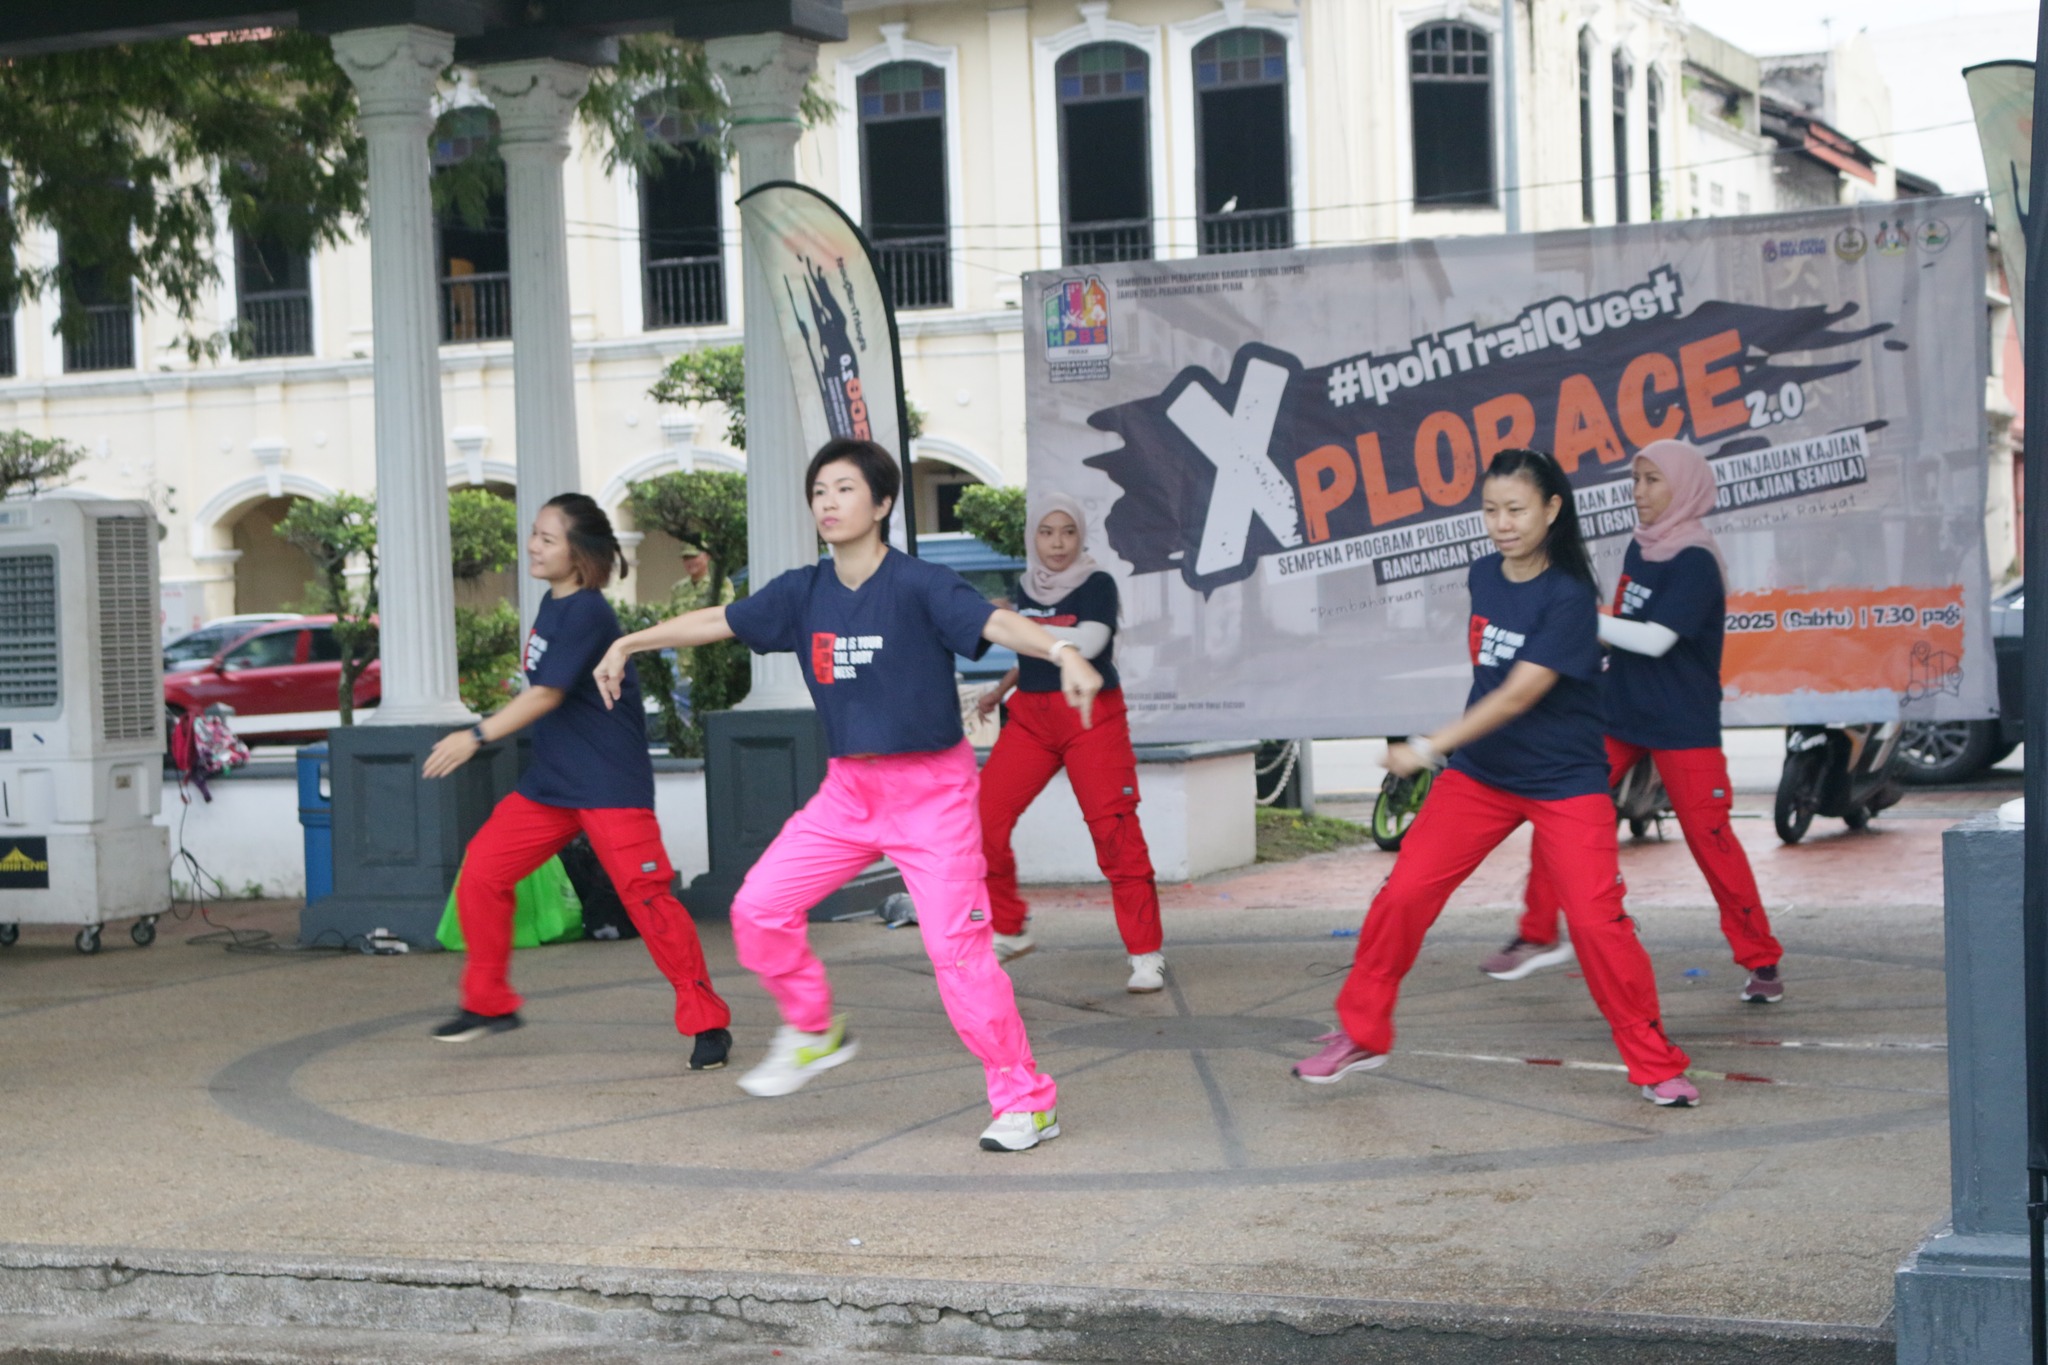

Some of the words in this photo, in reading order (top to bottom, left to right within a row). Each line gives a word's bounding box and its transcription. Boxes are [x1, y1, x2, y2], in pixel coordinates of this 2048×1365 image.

[1047, 326, 1107, 347] HPBS
[1327, 270, 1680, 406] #IpohTrailQuest
[1745, 382, 1804, 429] 2.0
[1277, 548, 1343, 577] SEMPENA
[1345, 536, 1414, 562] PROGRAM
[1416, 516, 1483, 546] PUBLISITI
[1611, 483, 1633, 505] AW
[1728, 447, 1802, 479] TINJAUAN
[1805, 433, 1862, 463] KAJIAN
[1381, 543, 1469, 581] RANCANGAN
[1470, 537, 1497, 562] STR
[1732, 472, 1795, 506] (KAJIAN
[1796, 456, 1866, 491] SEMULA)
[1725, 612, 1776, 631] 2025
